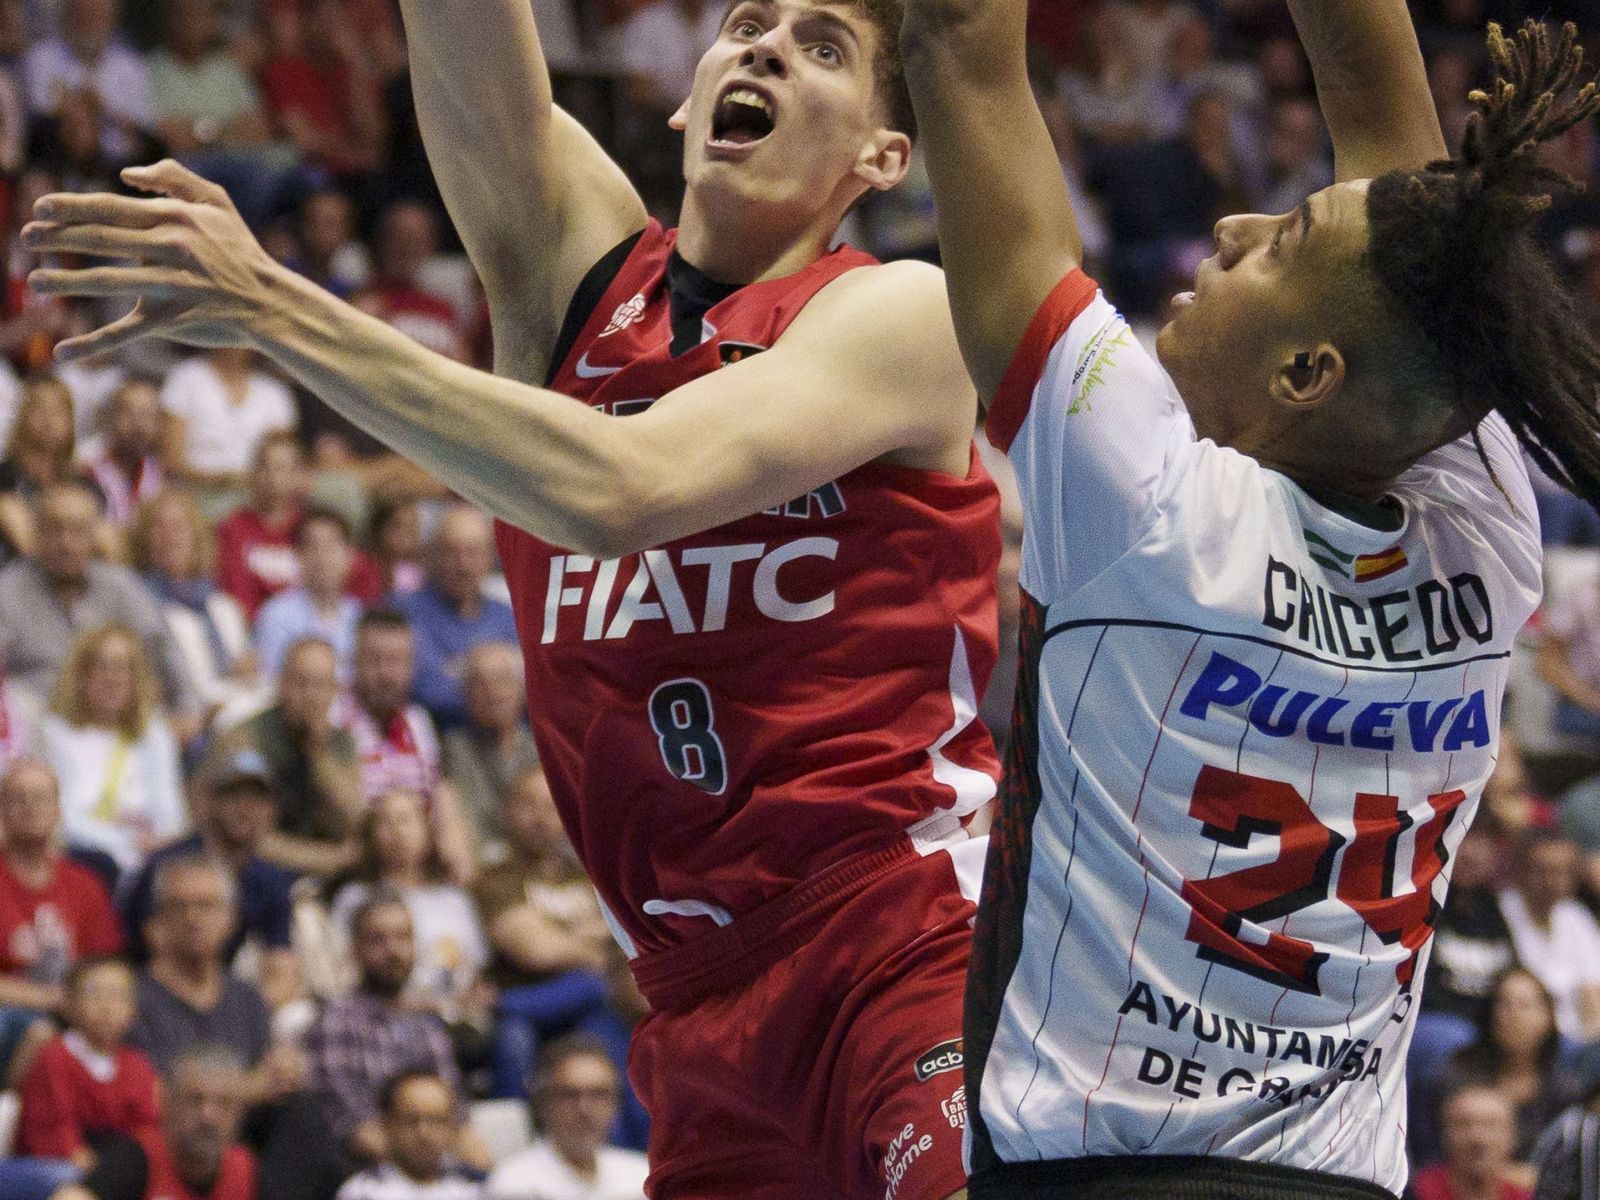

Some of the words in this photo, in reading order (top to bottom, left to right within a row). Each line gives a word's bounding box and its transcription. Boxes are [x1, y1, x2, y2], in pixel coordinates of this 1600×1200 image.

[541, 536, 840, 645] FIATC
[1262, 553, 1494, 663] CAICEDO
[648, 677, 728, 796] 8
[1179, 651, 1491, 753] PULEVA
[922, 1051, 964, 1074] acb
[1137, 1046, 1206, 1099] DE
